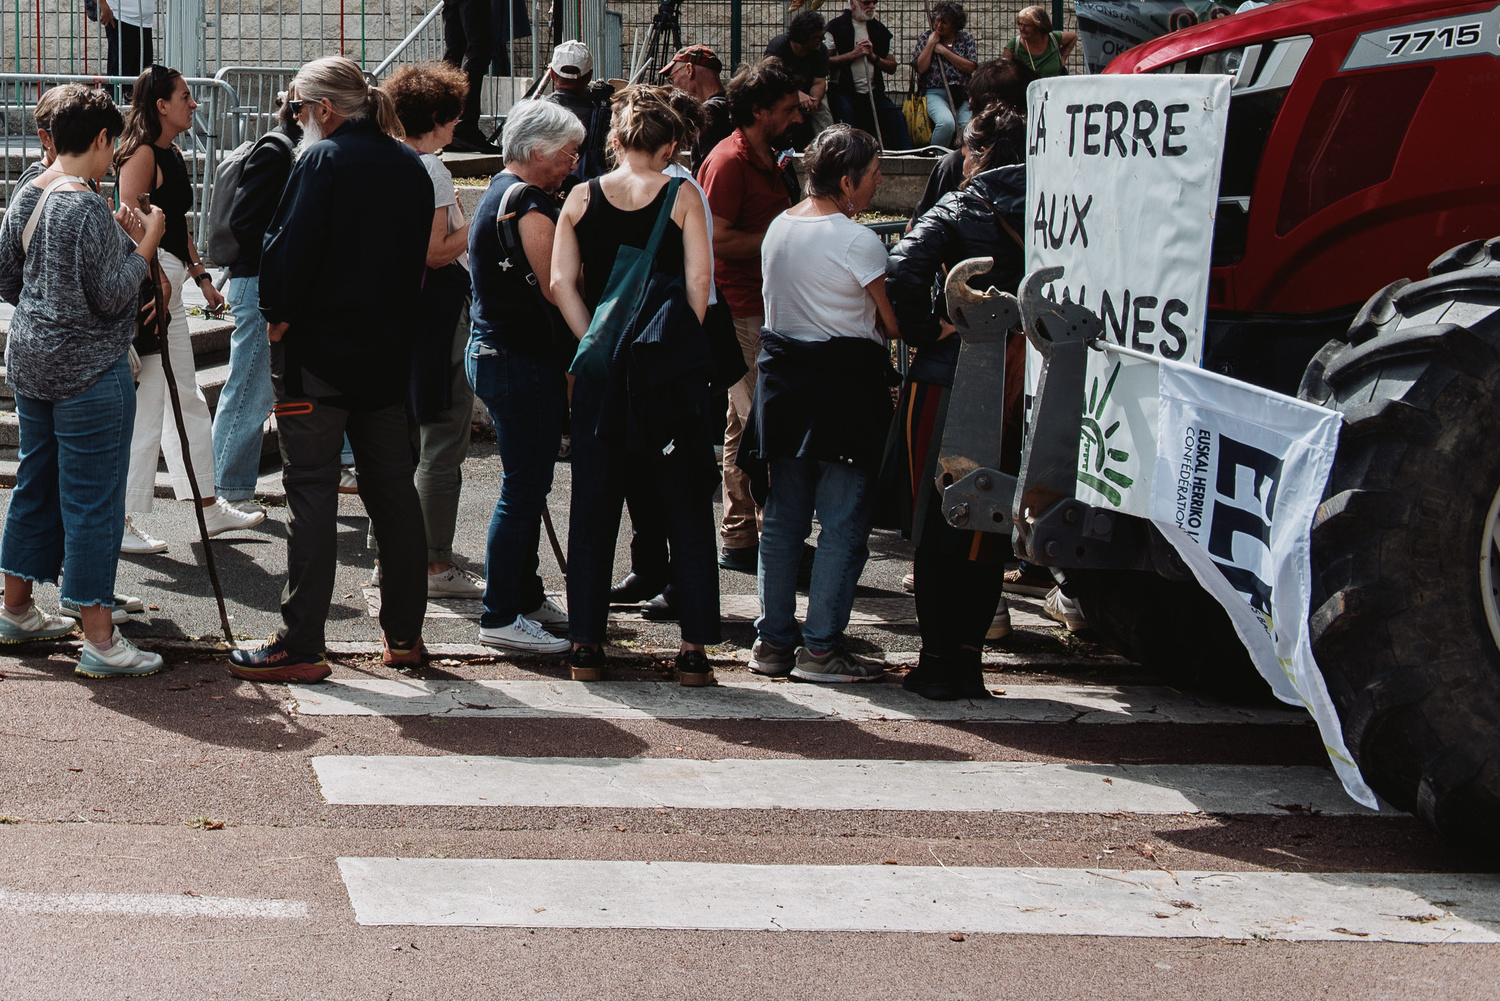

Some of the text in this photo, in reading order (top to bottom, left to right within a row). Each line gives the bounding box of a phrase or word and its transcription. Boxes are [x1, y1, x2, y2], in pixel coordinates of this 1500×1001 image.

[1386, 22, 1483, 58] 7715
[1029, 100, 1190, 158] LA TERRE
[1033, 191, 1093, 250] AUX
[1195, 429, 1211, 474] EUSKAL
[1175, 426, 1195, 530] CONFÉDÉRATION
[1188, 477, 1207, 529] HERRIKO
[265, 650, 288, 664] HOKA
